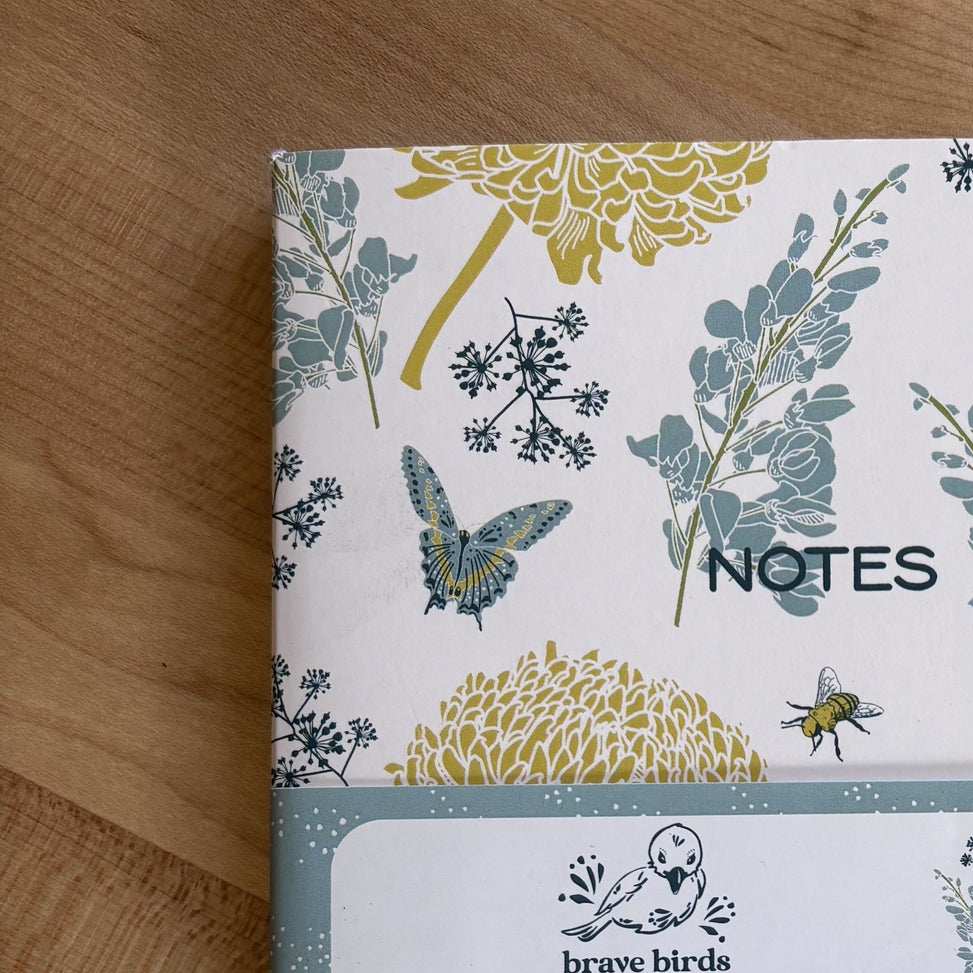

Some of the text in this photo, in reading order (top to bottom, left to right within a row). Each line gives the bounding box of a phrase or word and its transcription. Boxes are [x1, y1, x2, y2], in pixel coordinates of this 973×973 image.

[708, 545, 938, 593] NOTES
[562, 947, 731, 973] brave birds
